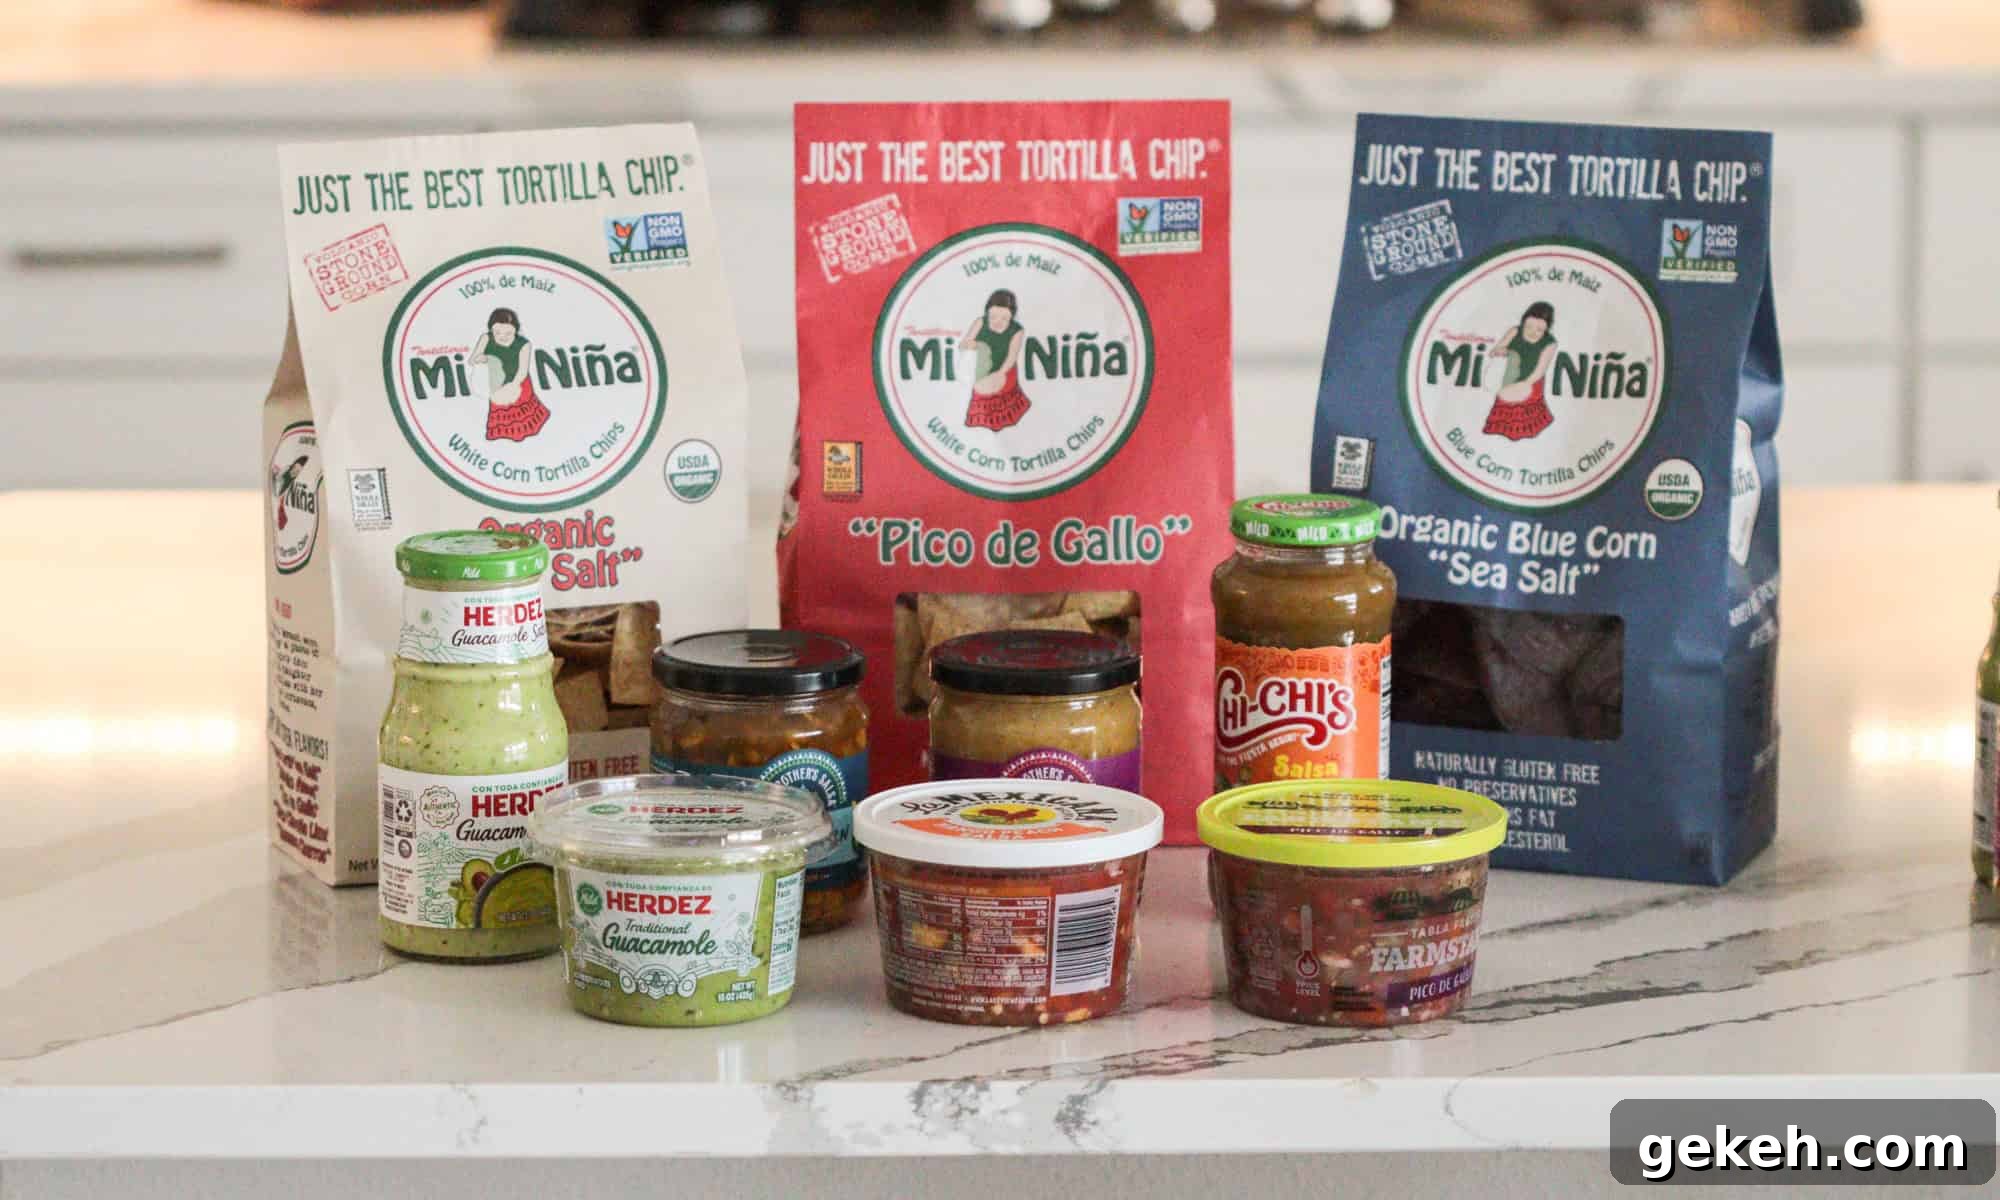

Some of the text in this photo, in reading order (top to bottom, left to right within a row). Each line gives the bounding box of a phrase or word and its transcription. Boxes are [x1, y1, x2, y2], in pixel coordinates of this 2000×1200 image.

[802, 142, 867, 184] JUST
[879, 142, 928, 183] THE
[940, 141, 1004, 182] BEST
[1017, 138, 1137, 182] TORTILLA
[1359, 143, 1424, 186] JUST
[1435, 147, 1480, 191] THE
[1492, 152, 1557, 195] BEST
[1568, 155, 1681, 200] TORTILLA
[292, 174, 351, 215] JUST
[365, 172, 412, 212] THE
[426, 168, 483, 209] BEST
[497, 161, 615, 206] TORTILLA
[1163, 201, 1197, 211] NON
[1163, 211, 1197, 221] GMO
[647, 215, 680, 226] NON
[648, 226, 682, 238] GMO
[1705, 224, 1737, 236] NON
[1371, 216, 1449, 251] STONE
[1704, 236, 1738, 248] GMO
[316, 240, 391, 280] STONE
[612, 248, 687, 263] VERIFIED
[1374, 232, 1453, 265] GROUND
[323, 254, 398, 296] GROUND
[963, 255, 1001, 277] 100%
[1005, 253, 1021, 268] de
[1505, 267, 1543, 289] 100%
[1547, 266, 1565, 282] de
[1666, 260, 1736, 271] VERIFIED
[458, 276, 496, 299] 100%
[499, 274, 516, 289] de
[899, 332, 1128, 381] Mi Niña
[410, 344, 642, 400] Mi Niña
[1427, 340, 1649, 399] Mi Niña
[449, 422, 625, 483] White Corn Tortilla Chips
[927, 415, 1105, 472] White Corn Tortilla Chips
[677, 455, 711, 469] USDA
[1446, 427, 1616, 487] Blue Corn Tortilla Chips
[1658, 474, 1690, 487] USDA
[1650, 491, 1695, 504] ORGANIC
[850, 514, 1192, 567] “Pico de Gallo”
[1245, 520, 1269, 536] MILD
[1297, 525, 1328, 542] MILD
[1378, 505, 1657, 560] Organic Blue Corn
[1428, 549, 1601, 595] “Sea Salt”
[463, 598, 543, 627] HERDEZ
[605, 754, 640, 777] FREE
[1273, 754, 1339, 778] Salsa
[1414, 751, 1600, 784] NATURALLY GLUTEN FREE
[472, 785, 492, 793] CON
[495, 784, 518, 792] TODA
[1463, 779, 1577, 806] PRESERVATIVES
[629, 805, 745, 815] HERDEZ
[1529, 809, 1555, 828] FAT
[606, 890, 712, 916] HERDEZ
[602, 922, 718, 956] Guacamole
[624, 919, 691, 934] Traditional
[1409, 982, 1437, 1001] PICO
[1439, 977, 1451, 993] DE
